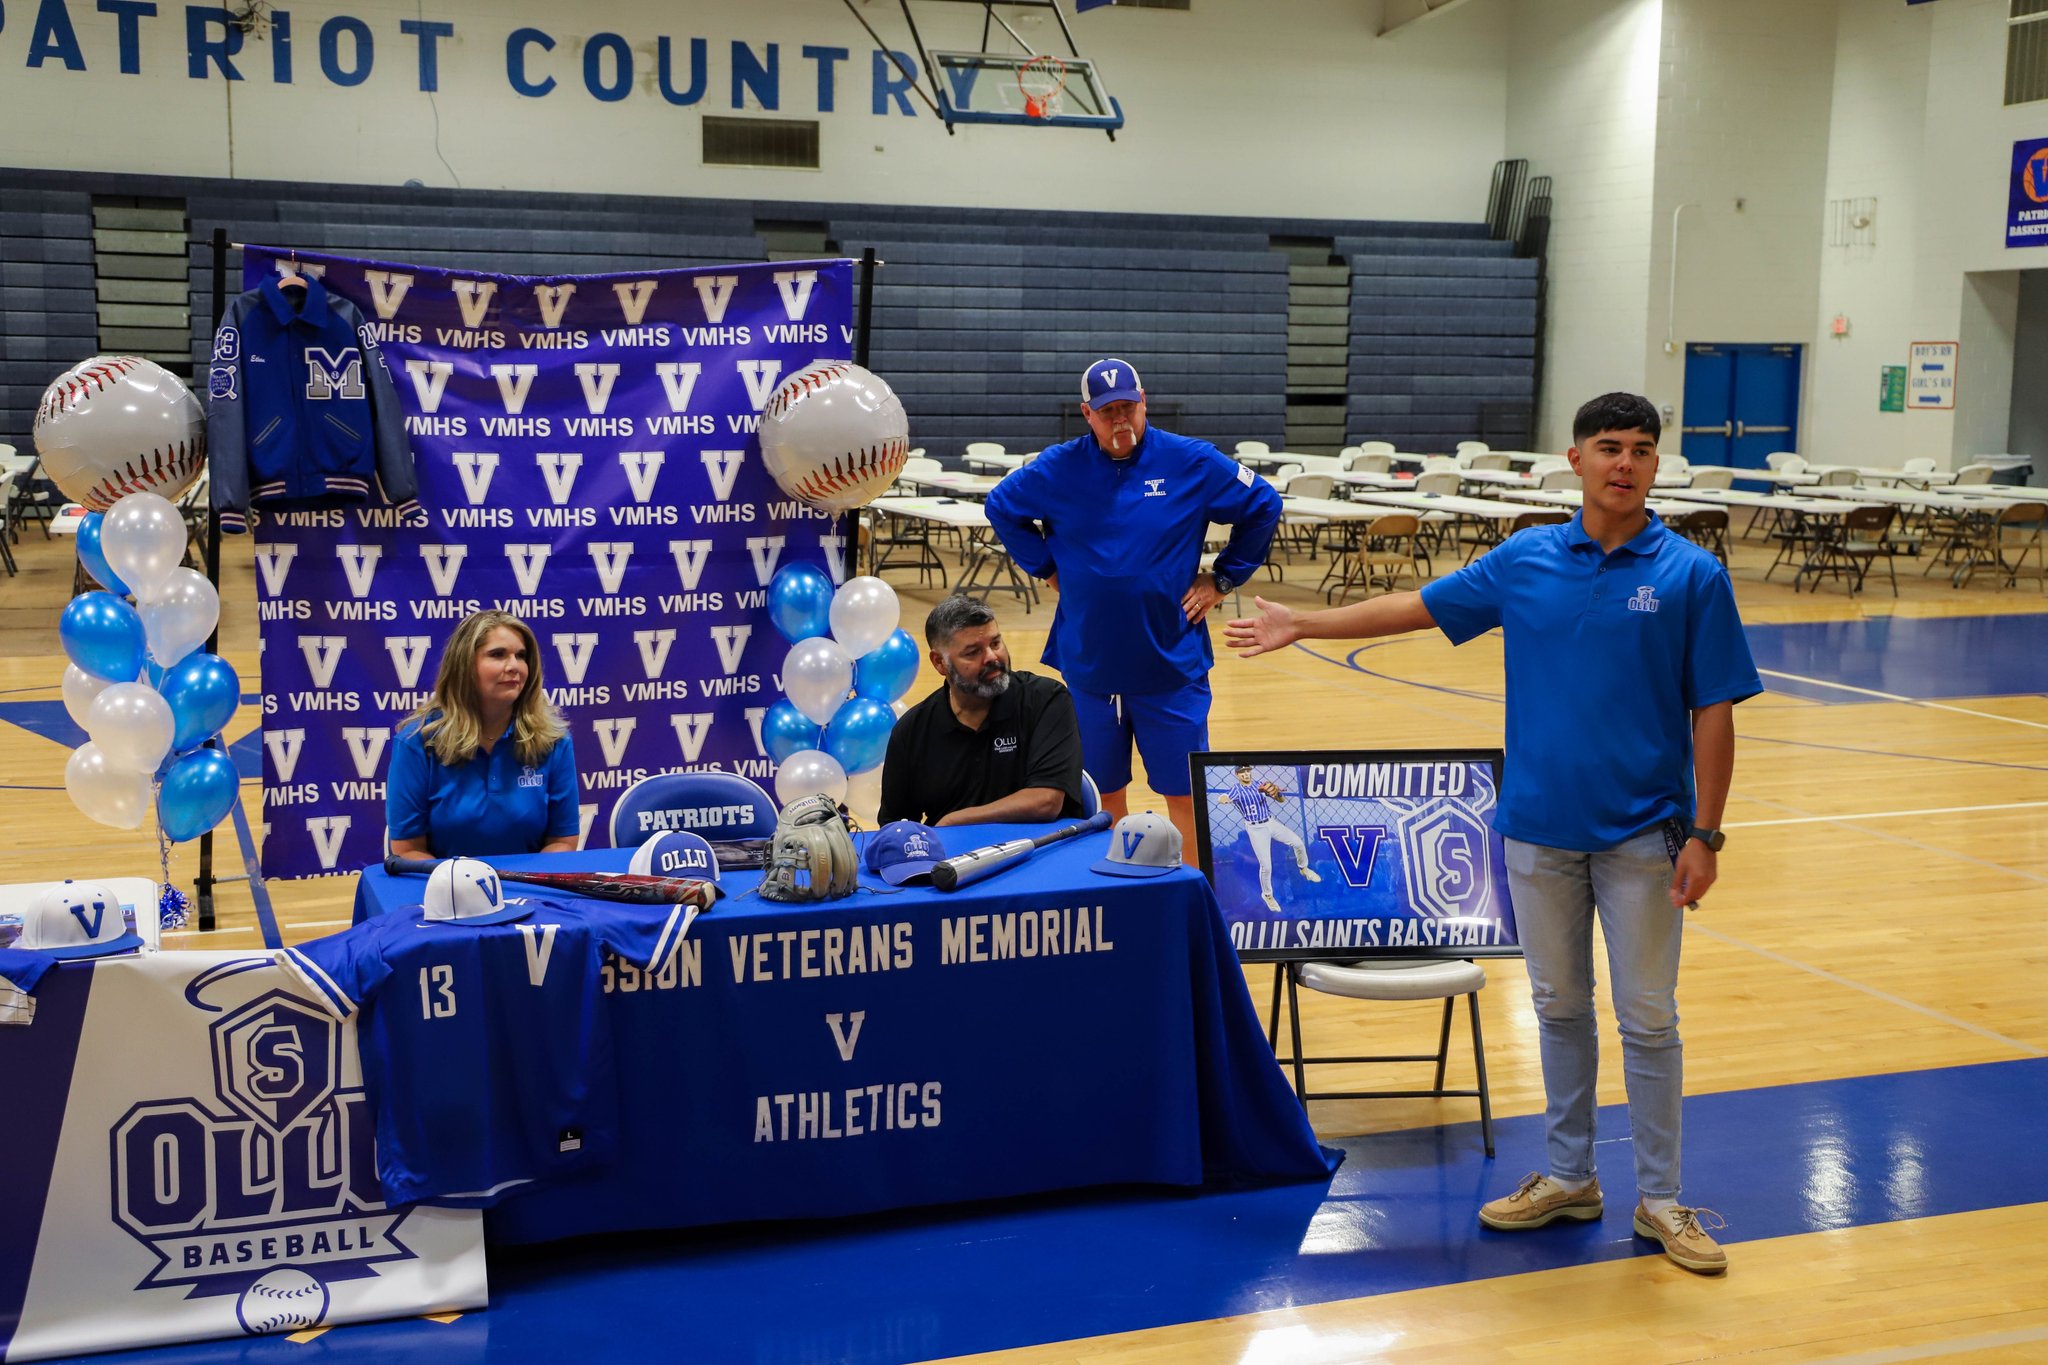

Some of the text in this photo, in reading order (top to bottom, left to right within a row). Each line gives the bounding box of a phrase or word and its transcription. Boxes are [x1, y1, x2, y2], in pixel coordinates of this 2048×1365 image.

[0, 0, 980, 117] ATRIOT COUNTRY
[365, 270, 817, 328] V V V V V V
[367, 322, 422, 344] MHS
[436, 328, 506, 348] VMHS
[520, 331, 588, 349] VMHS
[601, 328, 670, 346] VMHS
[682, 327, 751, 346] VMHS
[763, 325, 828, 343] VMHS
[304, 347, 366, 400] M
[405, 360, 782, 414] V V V V V
[1101, 368, 1119, 389] V
[480, 418, 550, 436] VMHS
[563, 418, 633, 436] VMHS
[646, 415, 714, 434] VMHS
[728, 415, 760, 433] VM
[452, 451, 745, 504] V V V V
[274, 509, 345, 527] VMHS
[442, 509, 513, 527] VMHS
[526, 507, 597, 527] VMHS
[609, 506, 678, 525] VMHS
[691, 504, 755, 523] VMHS
[255, 544, 298, 597] V
[336, 545, 382, 597] V
[420, 545, 467, 596] V
[504, 544, 552, 595] V
[588, 542, 634, 593] V
[670, 540, 712, 590] V
[747, 536, 785, 586] V
[325, 601, 397, 620] VMHS
[410, 600, 480, 618] VMHS
[578, 597, 646, 616] VMHS
[659, 593, 723, 613] VMHS
[736, 591, 767, 608] VM
[298, 625, 752, 688] V V V V V
[289, 692, 360, 711] VMHS
[373, 692, 434, 710] VMH
[545, 686, 610, 707] VMHS
[623, 681, 687, 702] VMHS
[700, 675, 760, 697] VMHS
[264, 728, 305, 782] V
[342, 727, 390, 778] V
[593, 717, 637, 767] V
[671, 713, 714, 762] V
[994, 736, 1017, 748] OLLU
[332, 782, 386, 800] VMH
[733, 760, 778, 778] VMH
[1307, 762, 1466, 799] COMMITTED
[637, 804, 755, 832] PATRIOTS
[306, 815, 351, 869] V
[661, 849, 708, 873] OLLU
[1121, 830, 1145, 860] V
[1318, 825, 1387, 888] V
[476, 874, 498, 908] V
[70, 901, 105, 938] V
[1293, 918, 1382, 948] SAINTS
[515, 924, 561, 987] V
[728, 922, 914, 984] VETERANS
[940, 906, 1114, 965] MEMORIAL
[419, 964, 457, 1020] 13
[825, 1010, 865, 1062] V
[754, 1081, 942, 1143] ATHLETICS
[183, 1226, 375, 1270] BASEBALL
